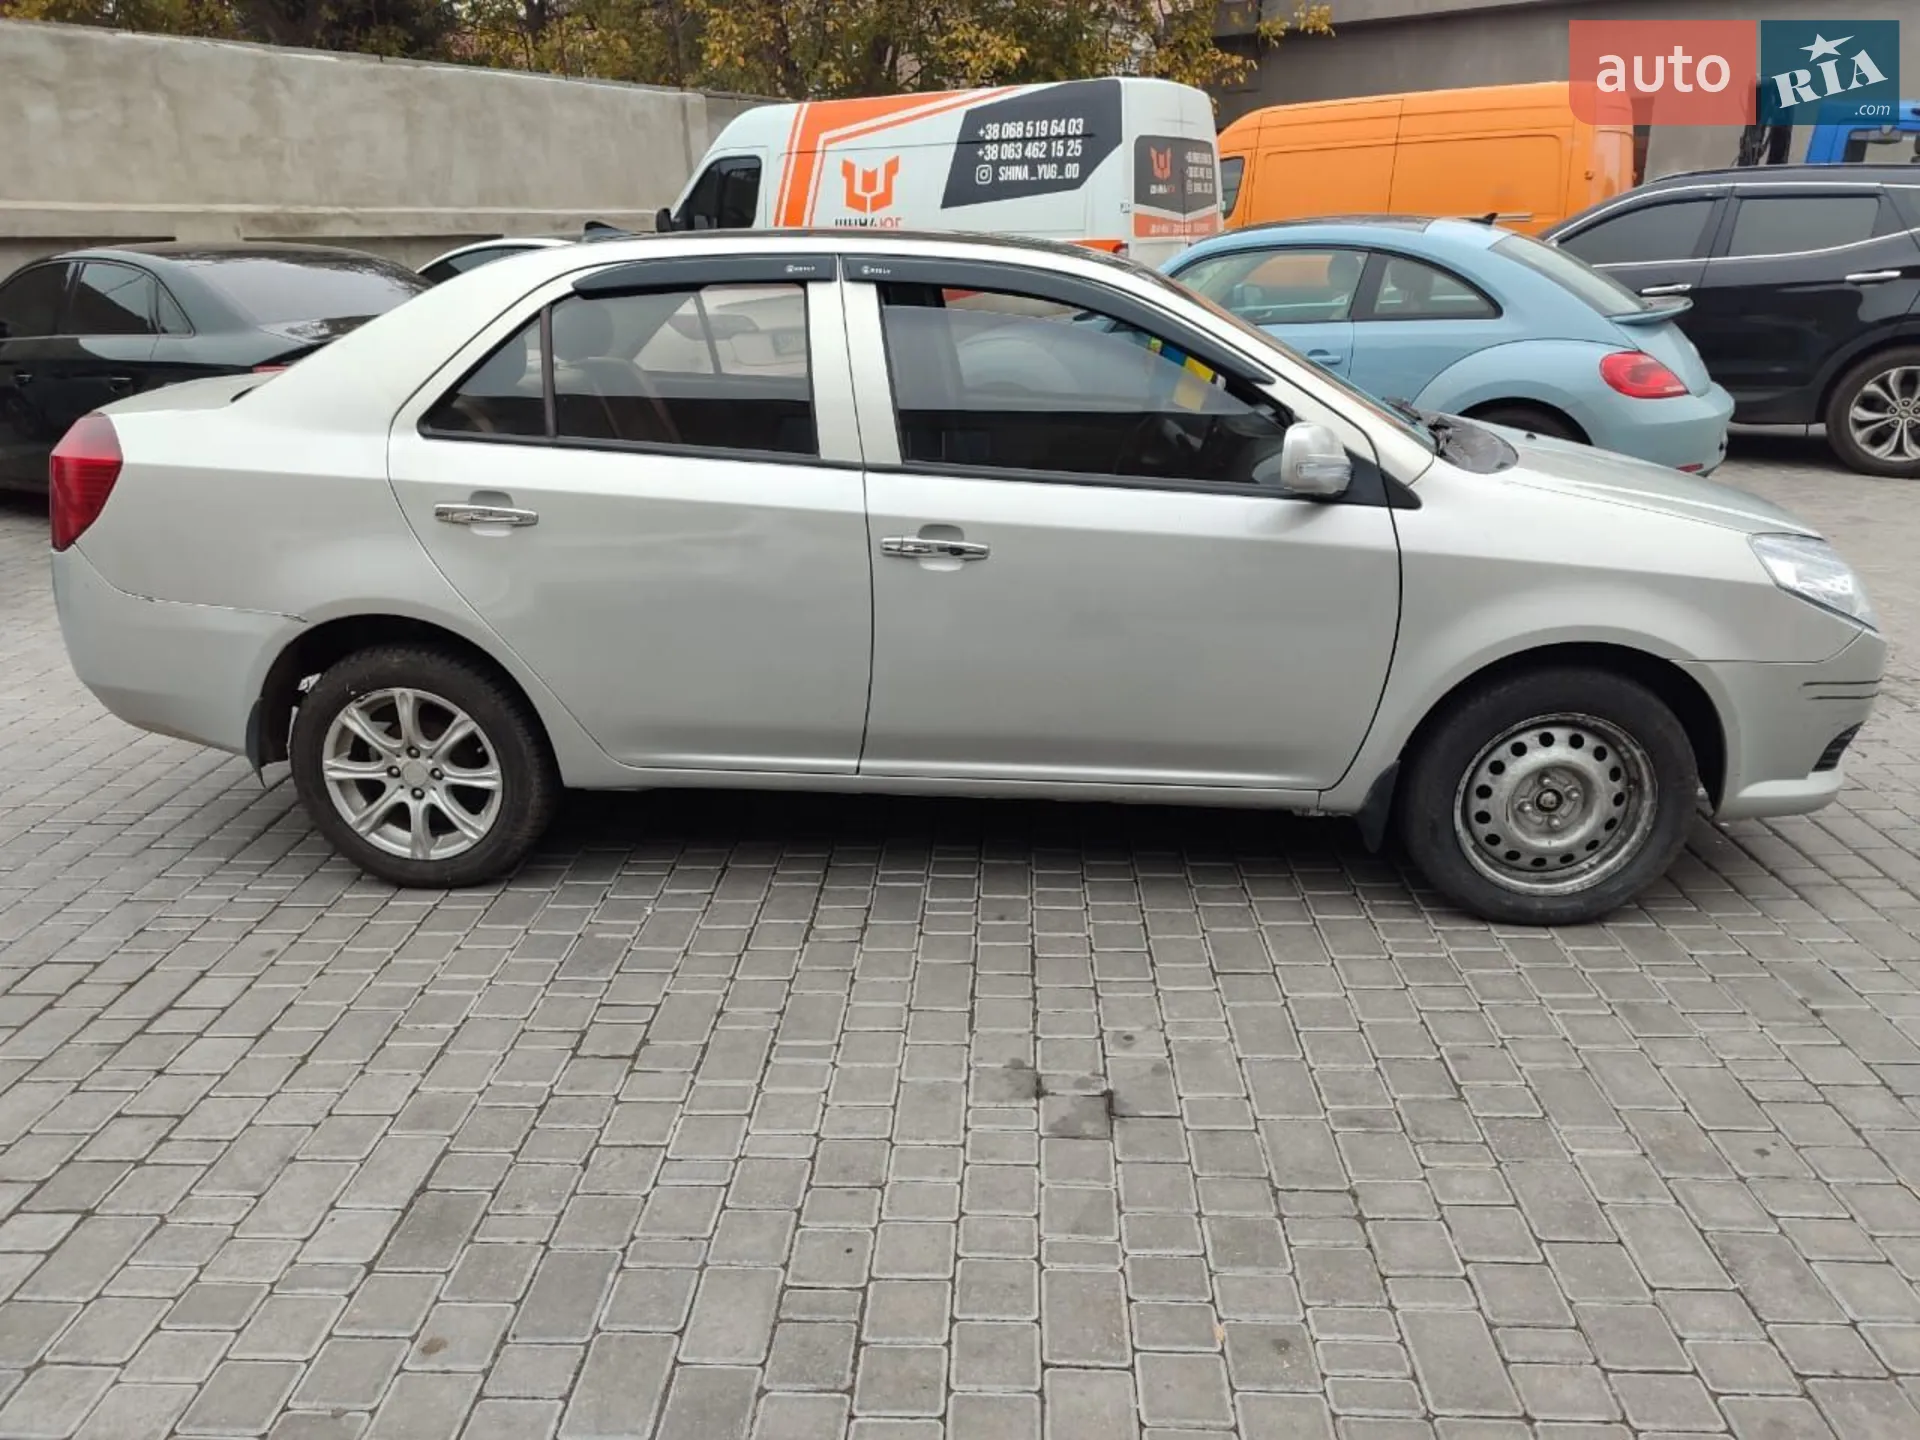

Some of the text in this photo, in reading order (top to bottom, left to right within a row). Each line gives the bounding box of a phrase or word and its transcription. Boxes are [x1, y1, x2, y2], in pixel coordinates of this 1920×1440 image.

[977, 118, 1084, 140] +38 068 519 64 03
[976, 139, 1083, 161] +38 063 462 15 25
